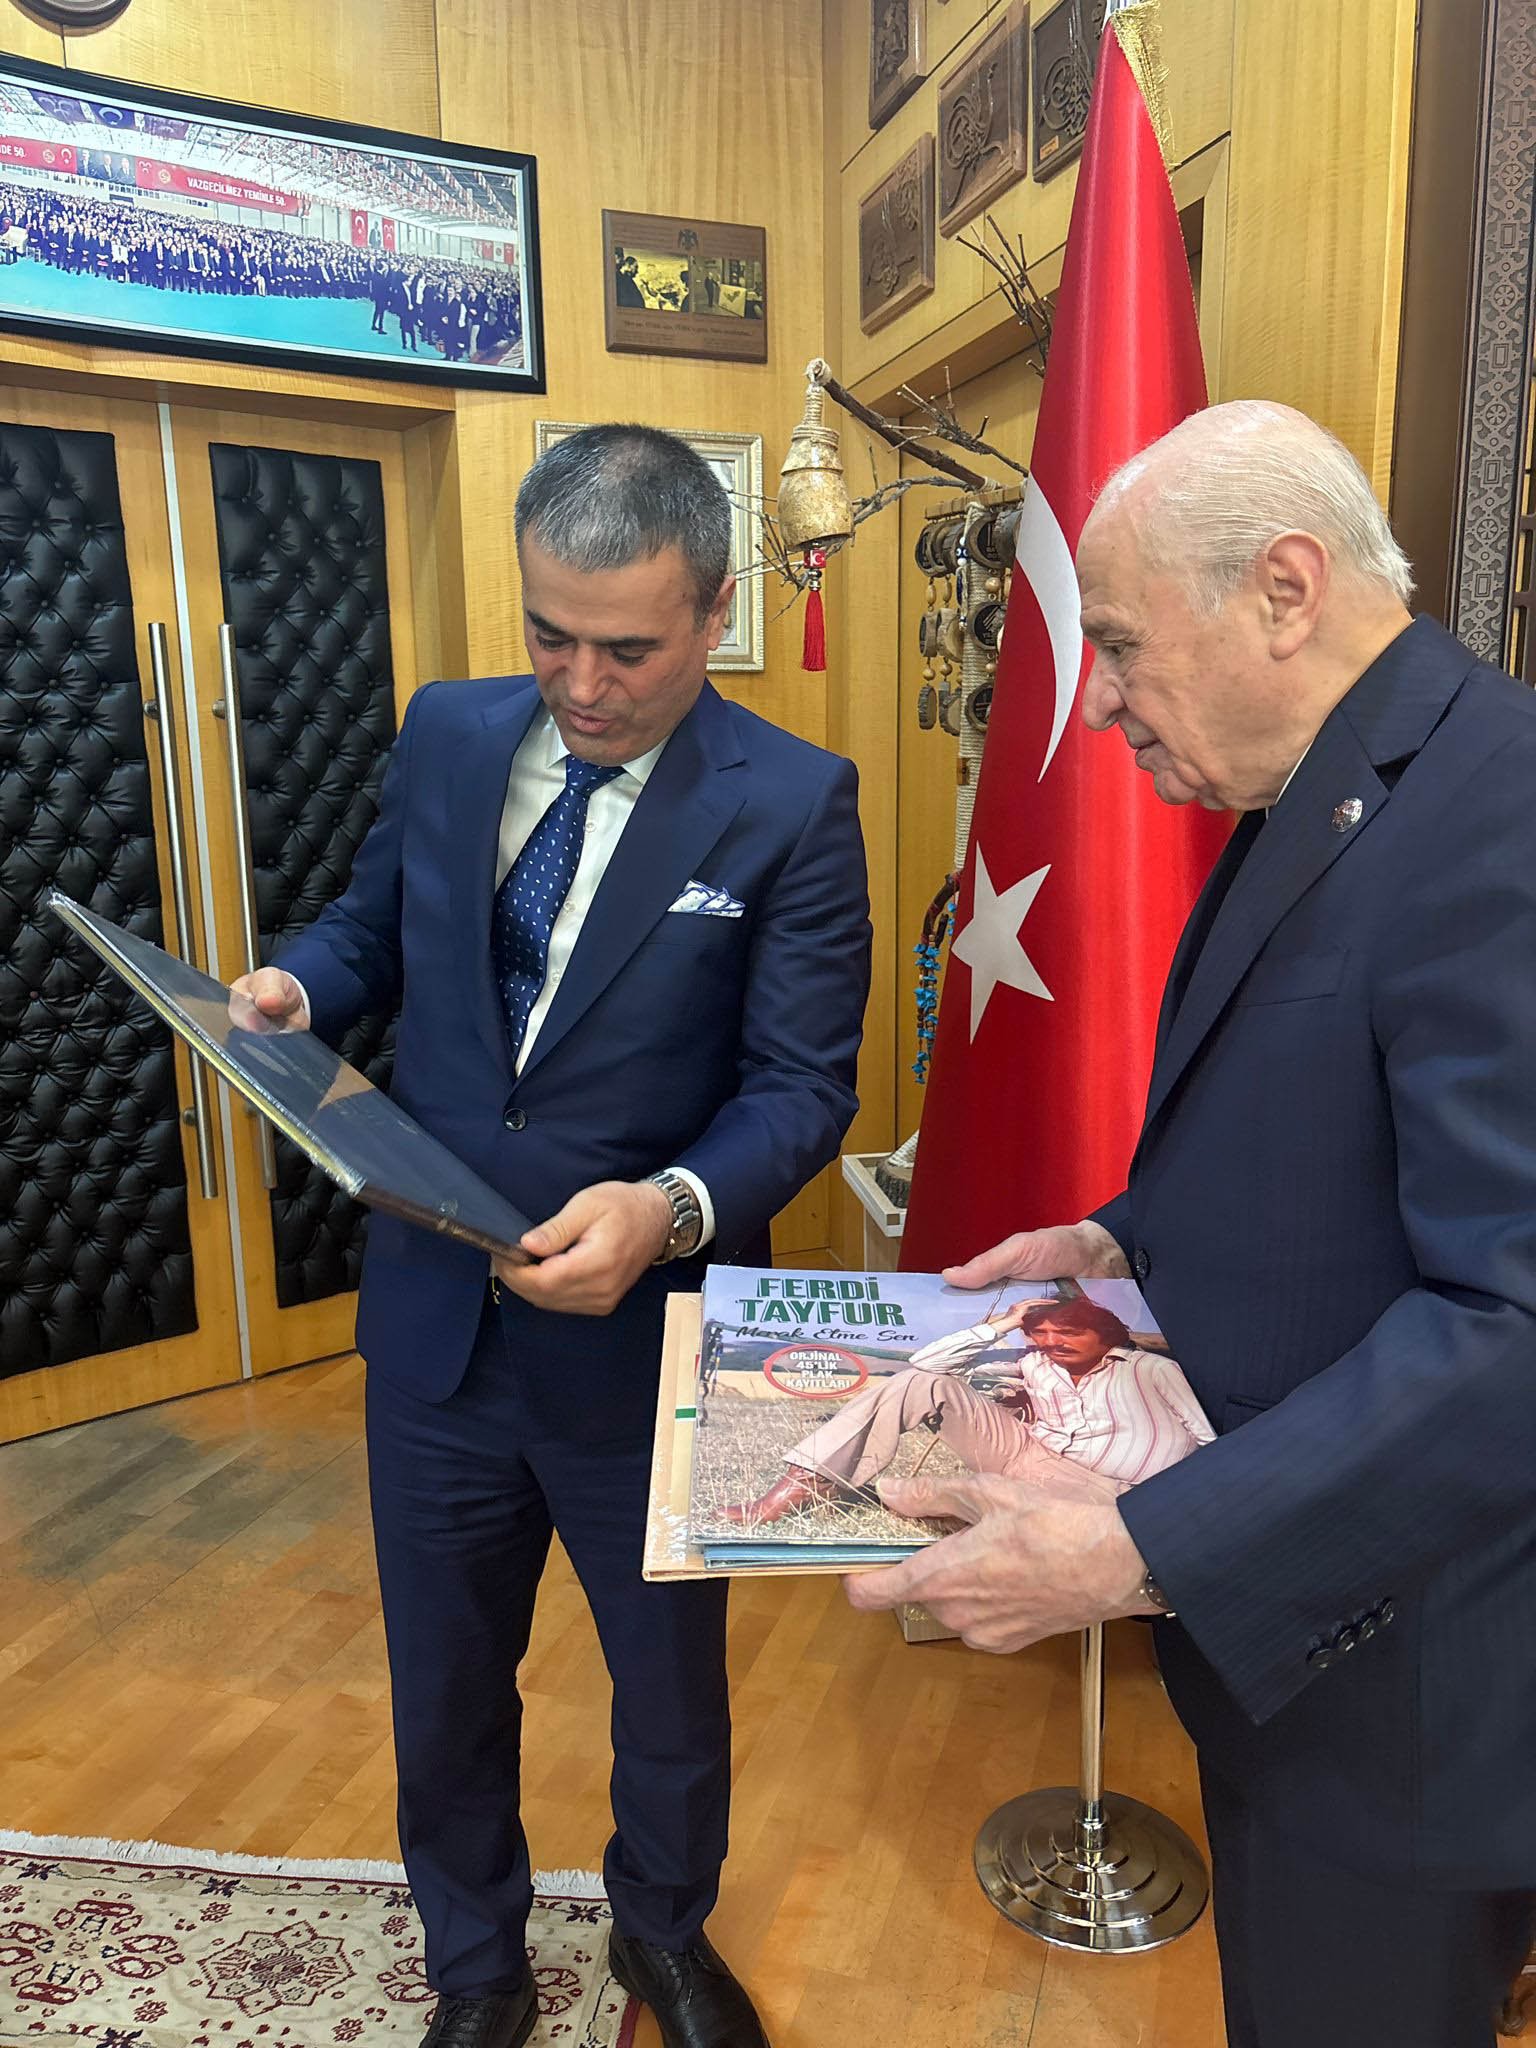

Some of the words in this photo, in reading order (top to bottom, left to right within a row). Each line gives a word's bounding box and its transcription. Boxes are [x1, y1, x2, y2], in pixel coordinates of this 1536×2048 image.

[757, 1277, 880, 1300] FERDİ
[736, 1299, 906, 1326] TAYFUR
[736, 1326, 804, 1338] Merak
[876, 1330, 919, 1342] Sen
[790, 1351, 842, 1361] ORJİNAL
[801, 1370, 834, 1379] PLAK
[785, 1379, 851, 1388] KAYITLARI
